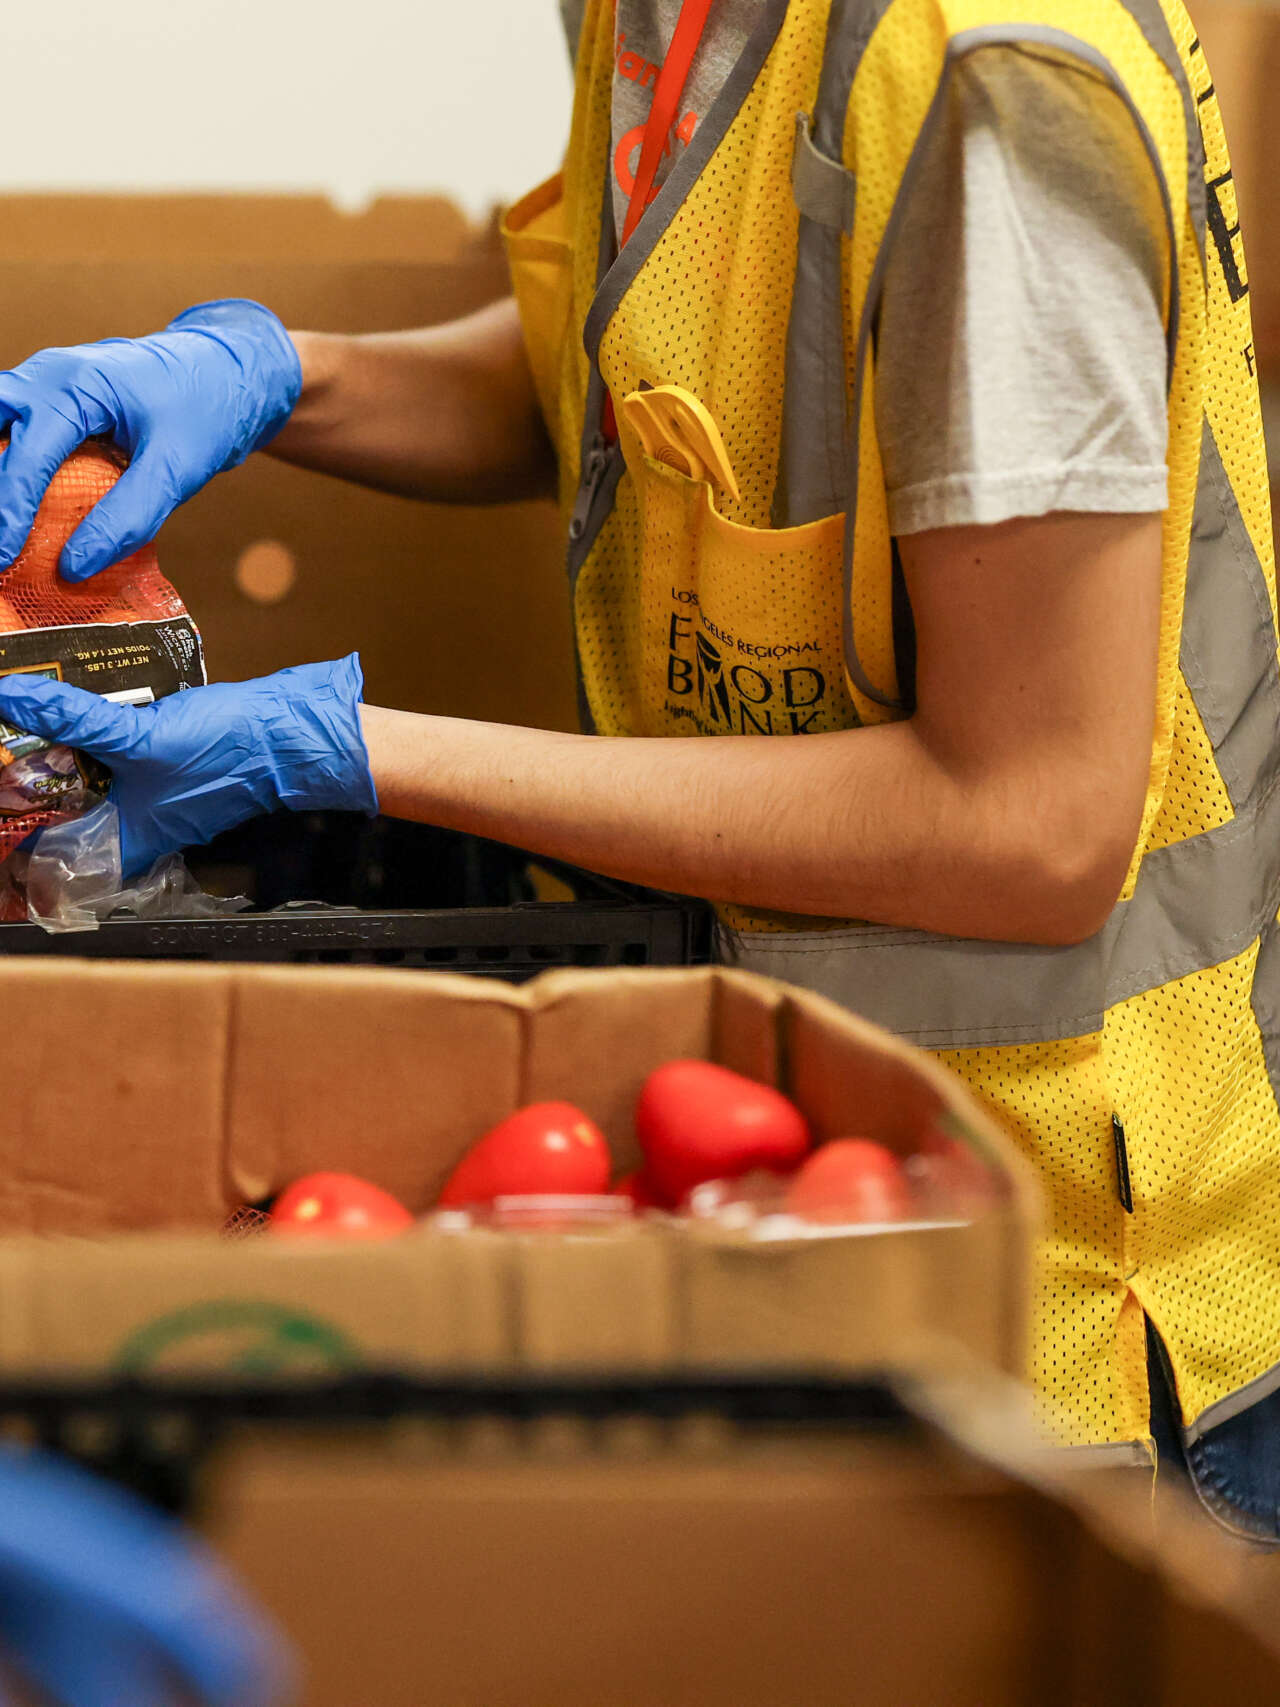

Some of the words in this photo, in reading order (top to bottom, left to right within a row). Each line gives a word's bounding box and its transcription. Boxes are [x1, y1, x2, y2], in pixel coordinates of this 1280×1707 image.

[672, 587, 699, 606] LOS
[701, 610, 733, 647] GELES
[737, 640, 822, 658] REGIONAL
[108, 647, 124, 656] NET
[108, 661, 113, 669] 3
[132, 656, 149, 665] NET
[85, 663, 105, 672] LBS.
